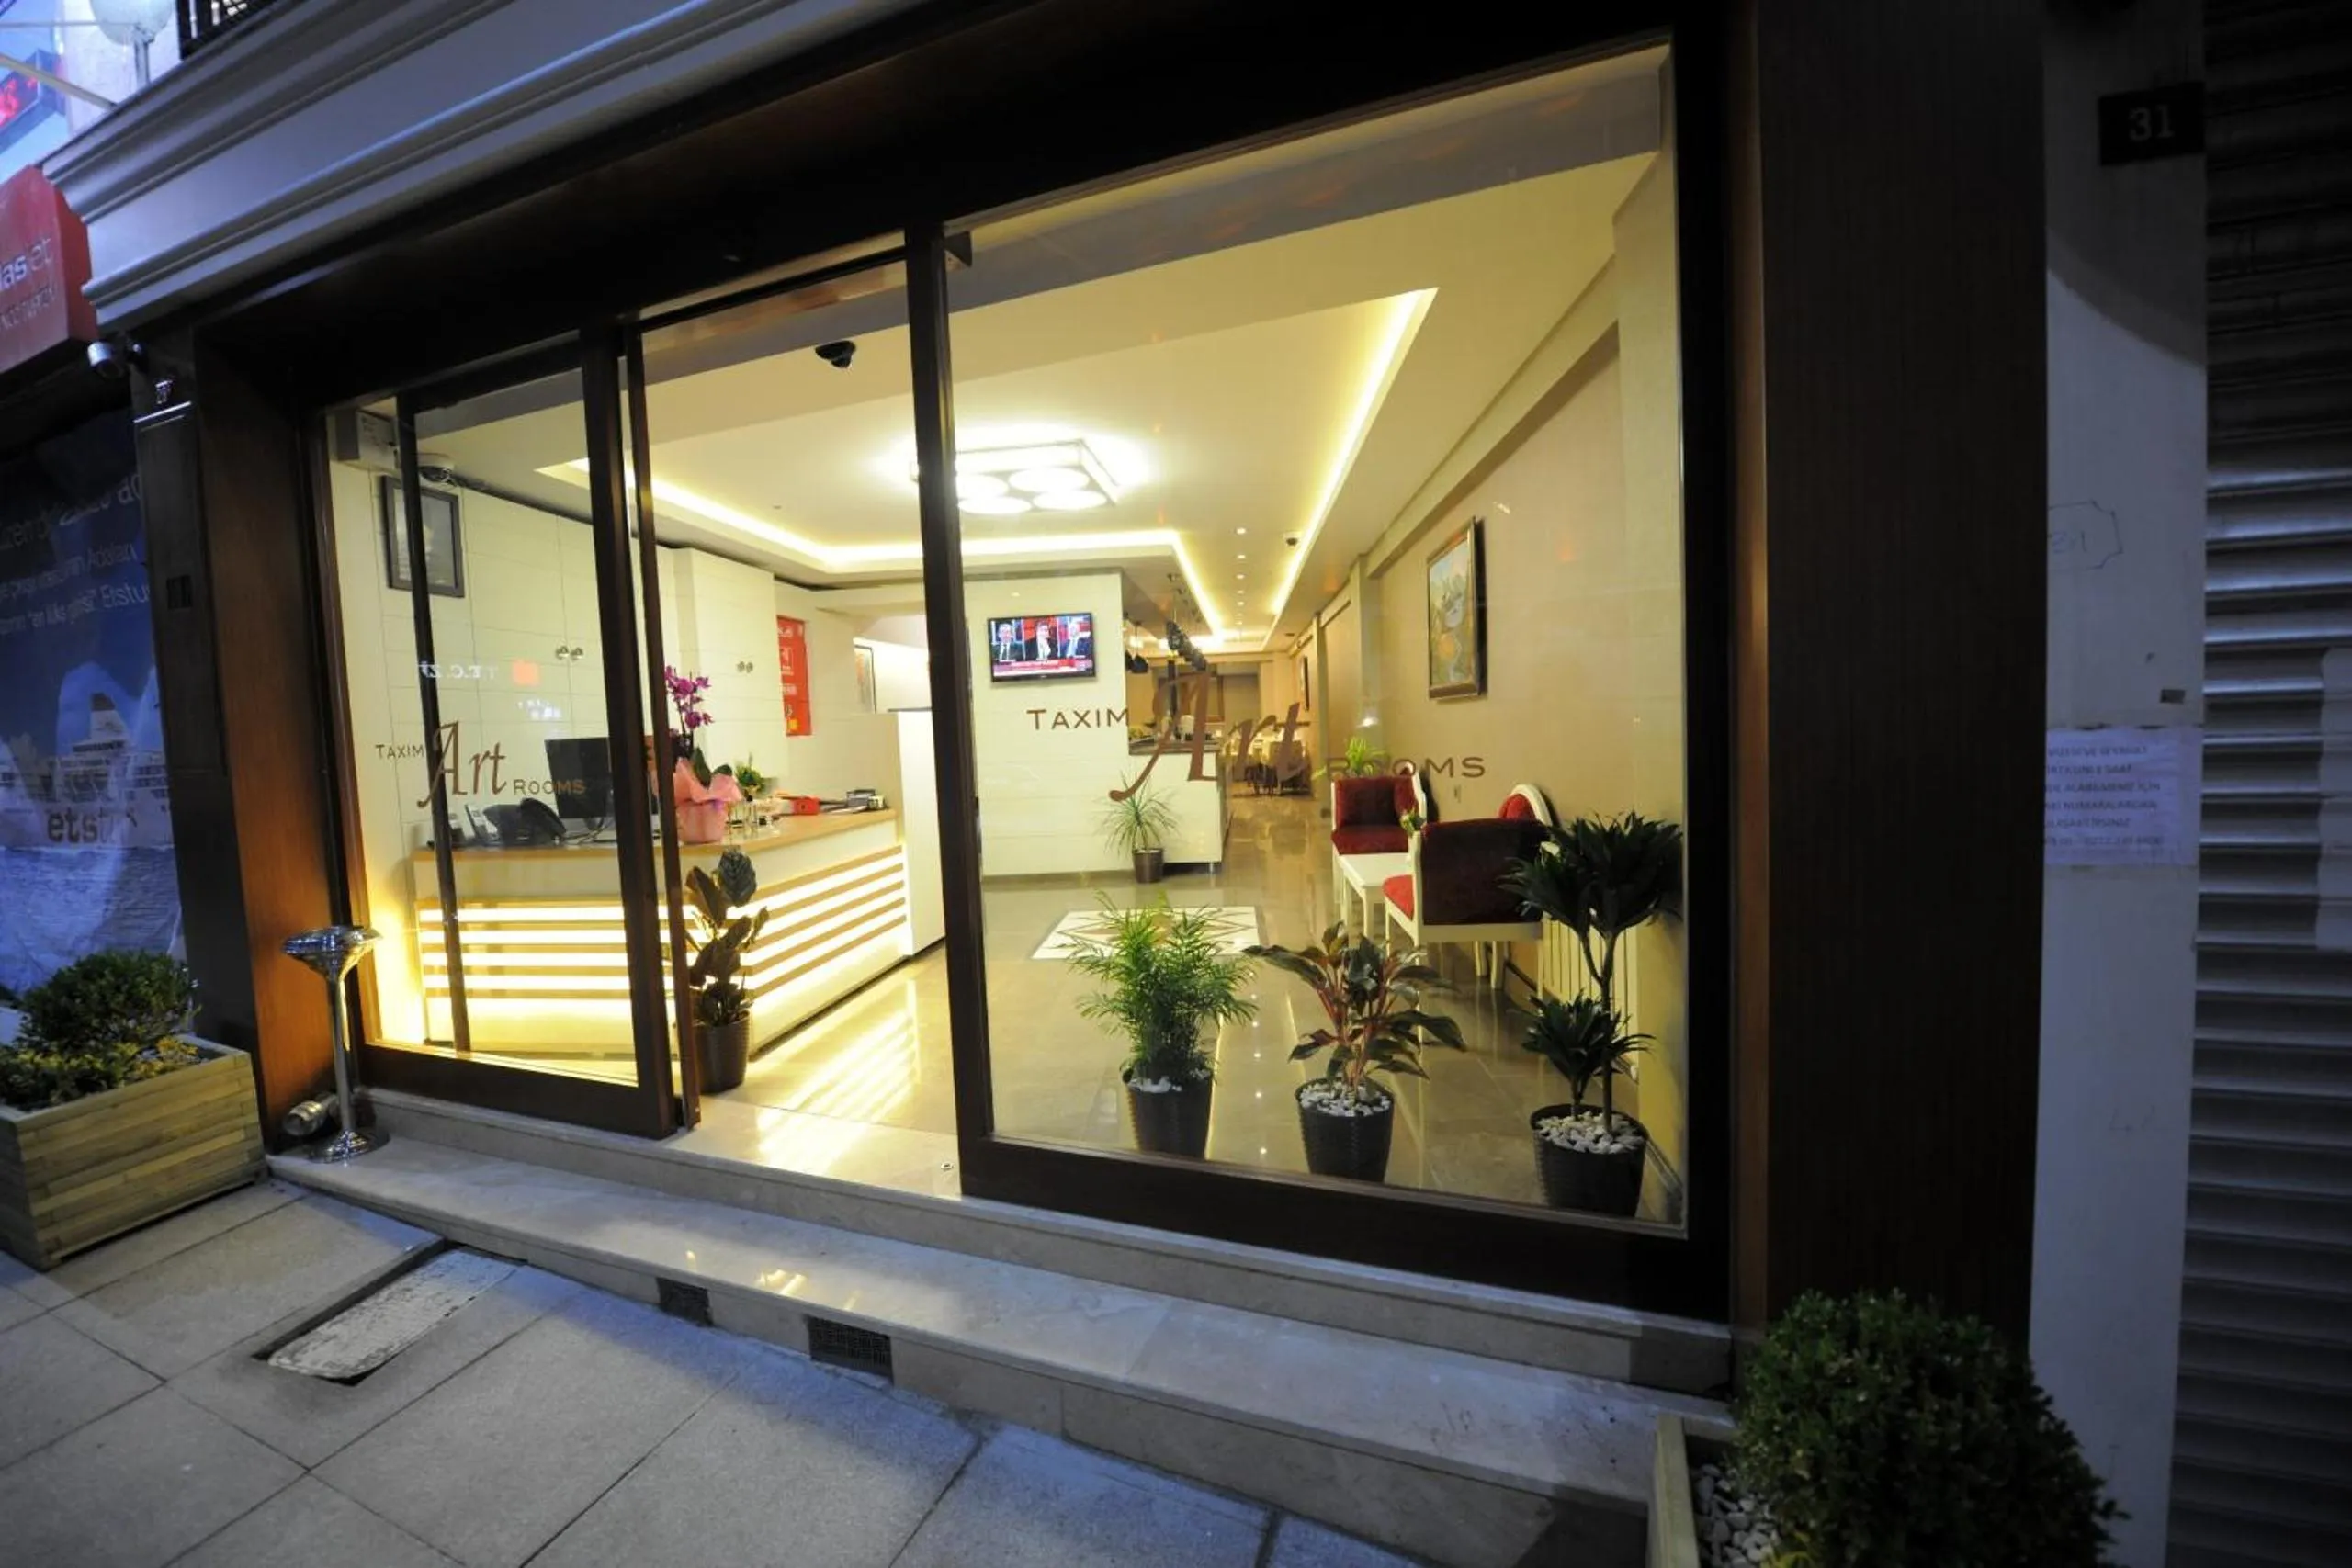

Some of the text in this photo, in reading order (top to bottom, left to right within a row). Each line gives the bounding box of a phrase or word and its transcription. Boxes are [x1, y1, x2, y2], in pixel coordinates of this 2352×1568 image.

[2128, 104, 2175, 141] 31
[375, 720, 586, 808] TAXIM Art ROOMS
[1026, 671, 1486, 802] TAXIM Art ROOMS
